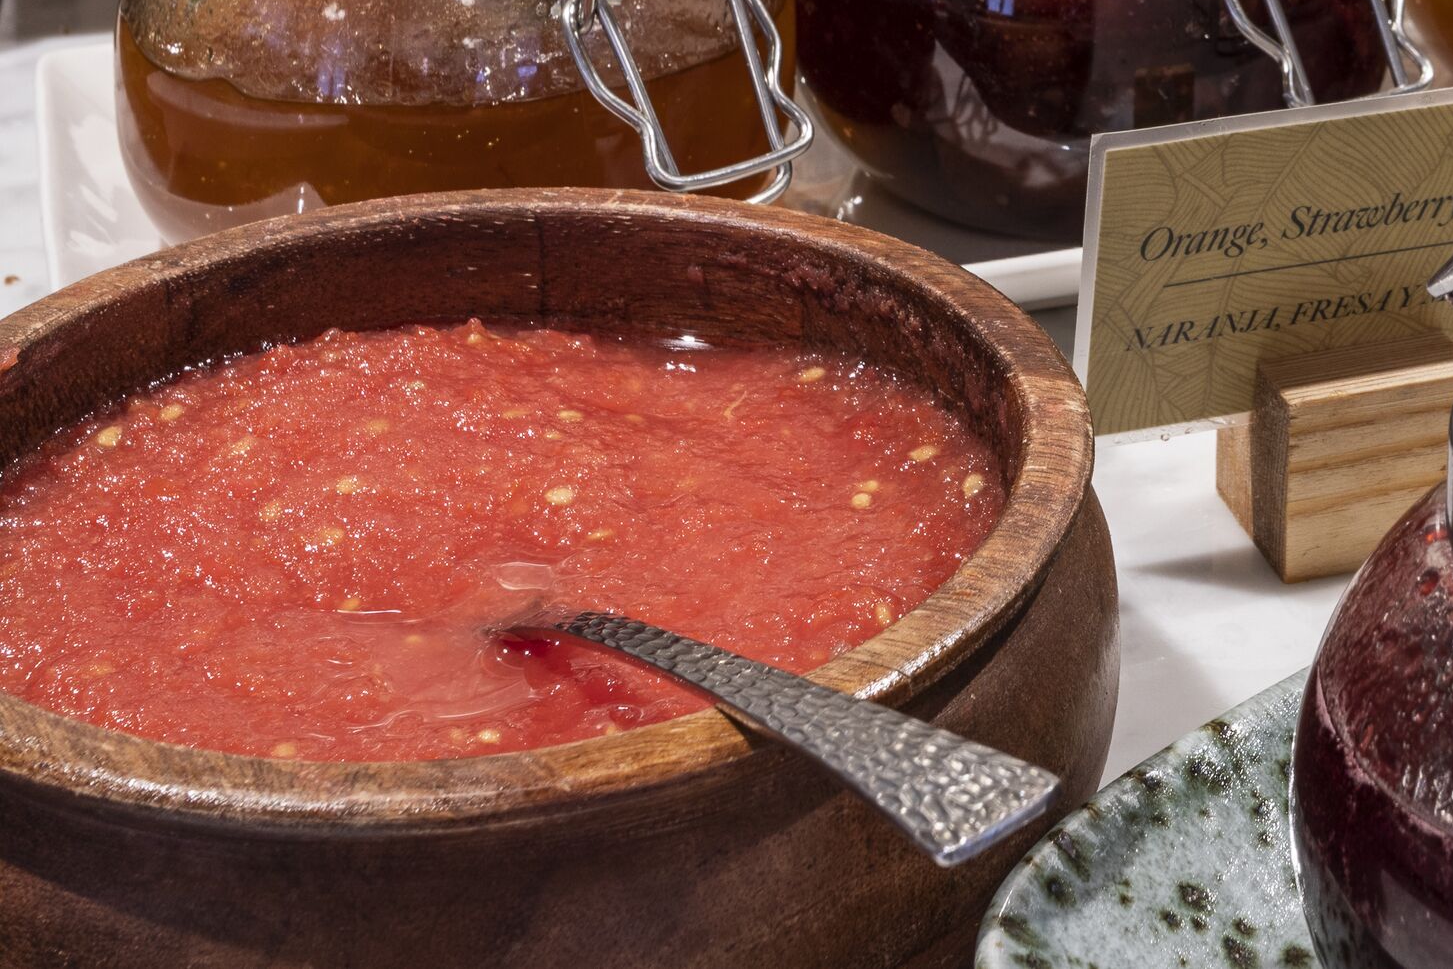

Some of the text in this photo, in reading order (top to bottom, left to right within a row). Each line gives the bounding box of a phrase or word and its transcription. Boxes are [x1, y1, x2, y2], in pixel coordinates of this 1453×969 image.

[1140, 219, 1268, 262] Orange,
[1124, 306, 1281, 352] NARANJA,
[1288, 289, 1394, 326] FRESA
[1400, 285, 1418, 309] Y
